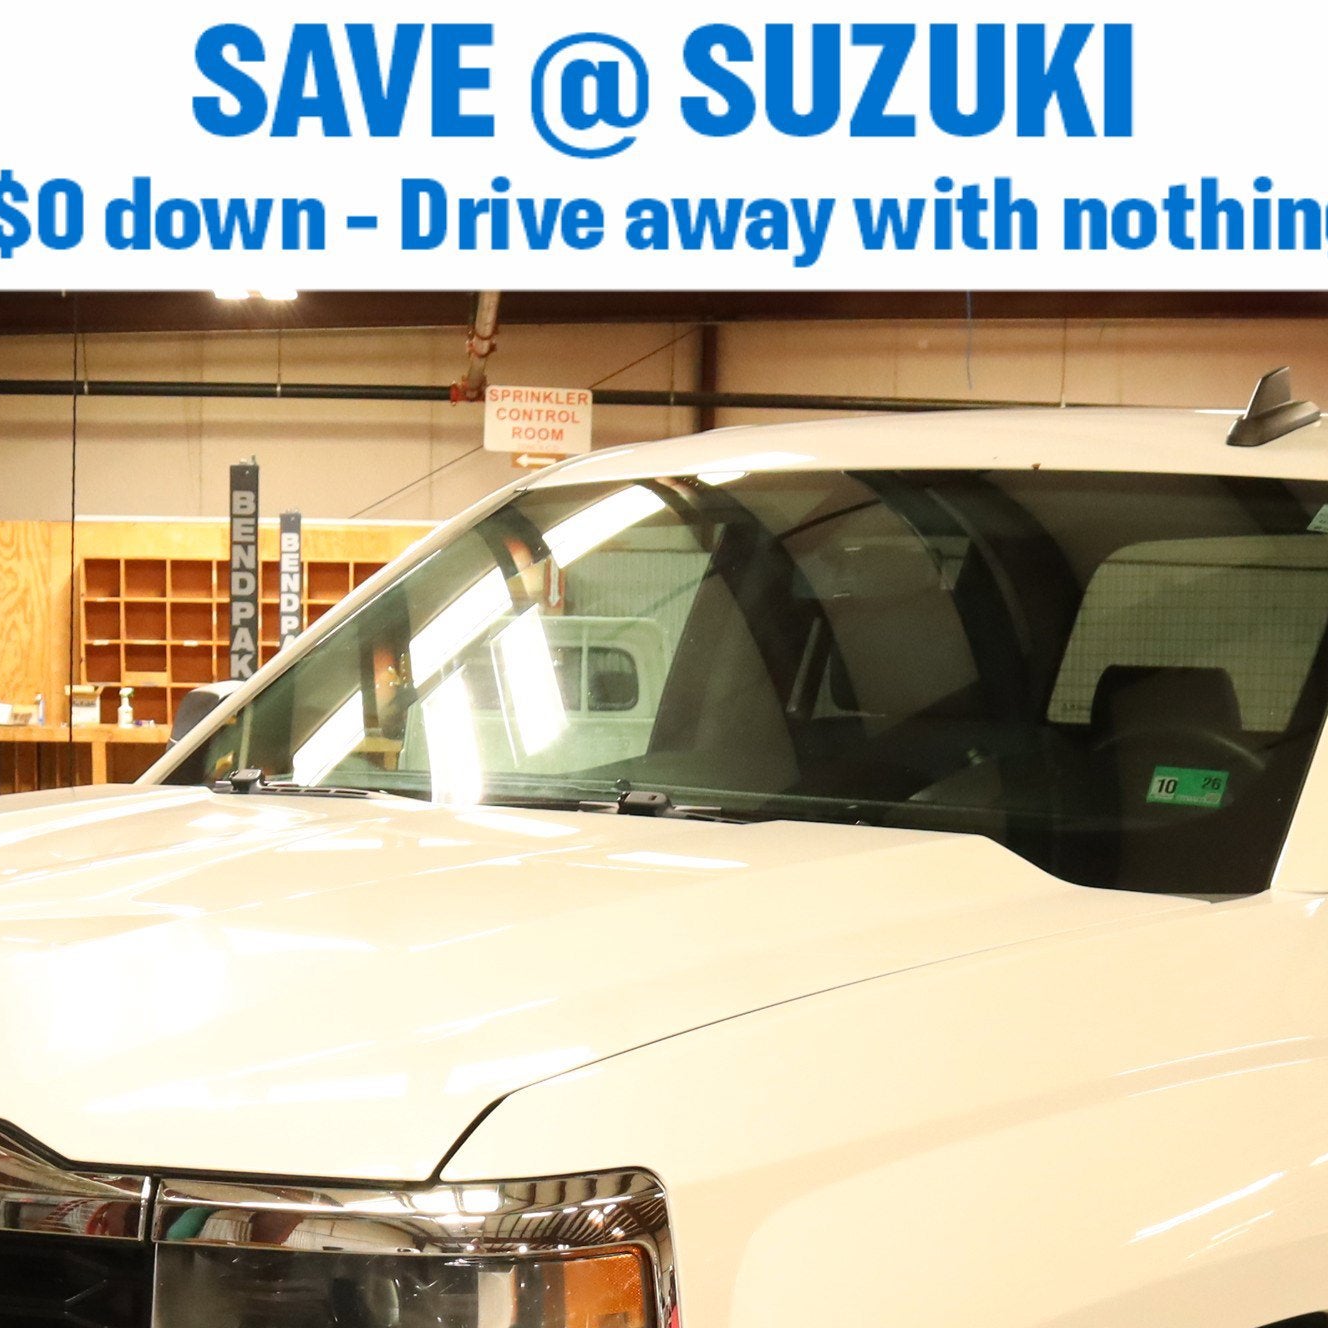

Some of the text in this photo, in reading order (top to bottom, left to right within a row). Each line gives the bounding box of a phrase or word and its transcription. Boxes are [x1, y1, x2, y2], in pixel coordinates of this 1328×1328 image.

[490, 389, 588, 406] SPRINKLER
[496, 407, 580, 424] CONTROL
[512, 427, 564, 441] ROOM
[230, 490, 256, 679] BENDPAK
[1157, 778, 1221, 794] 10 26
